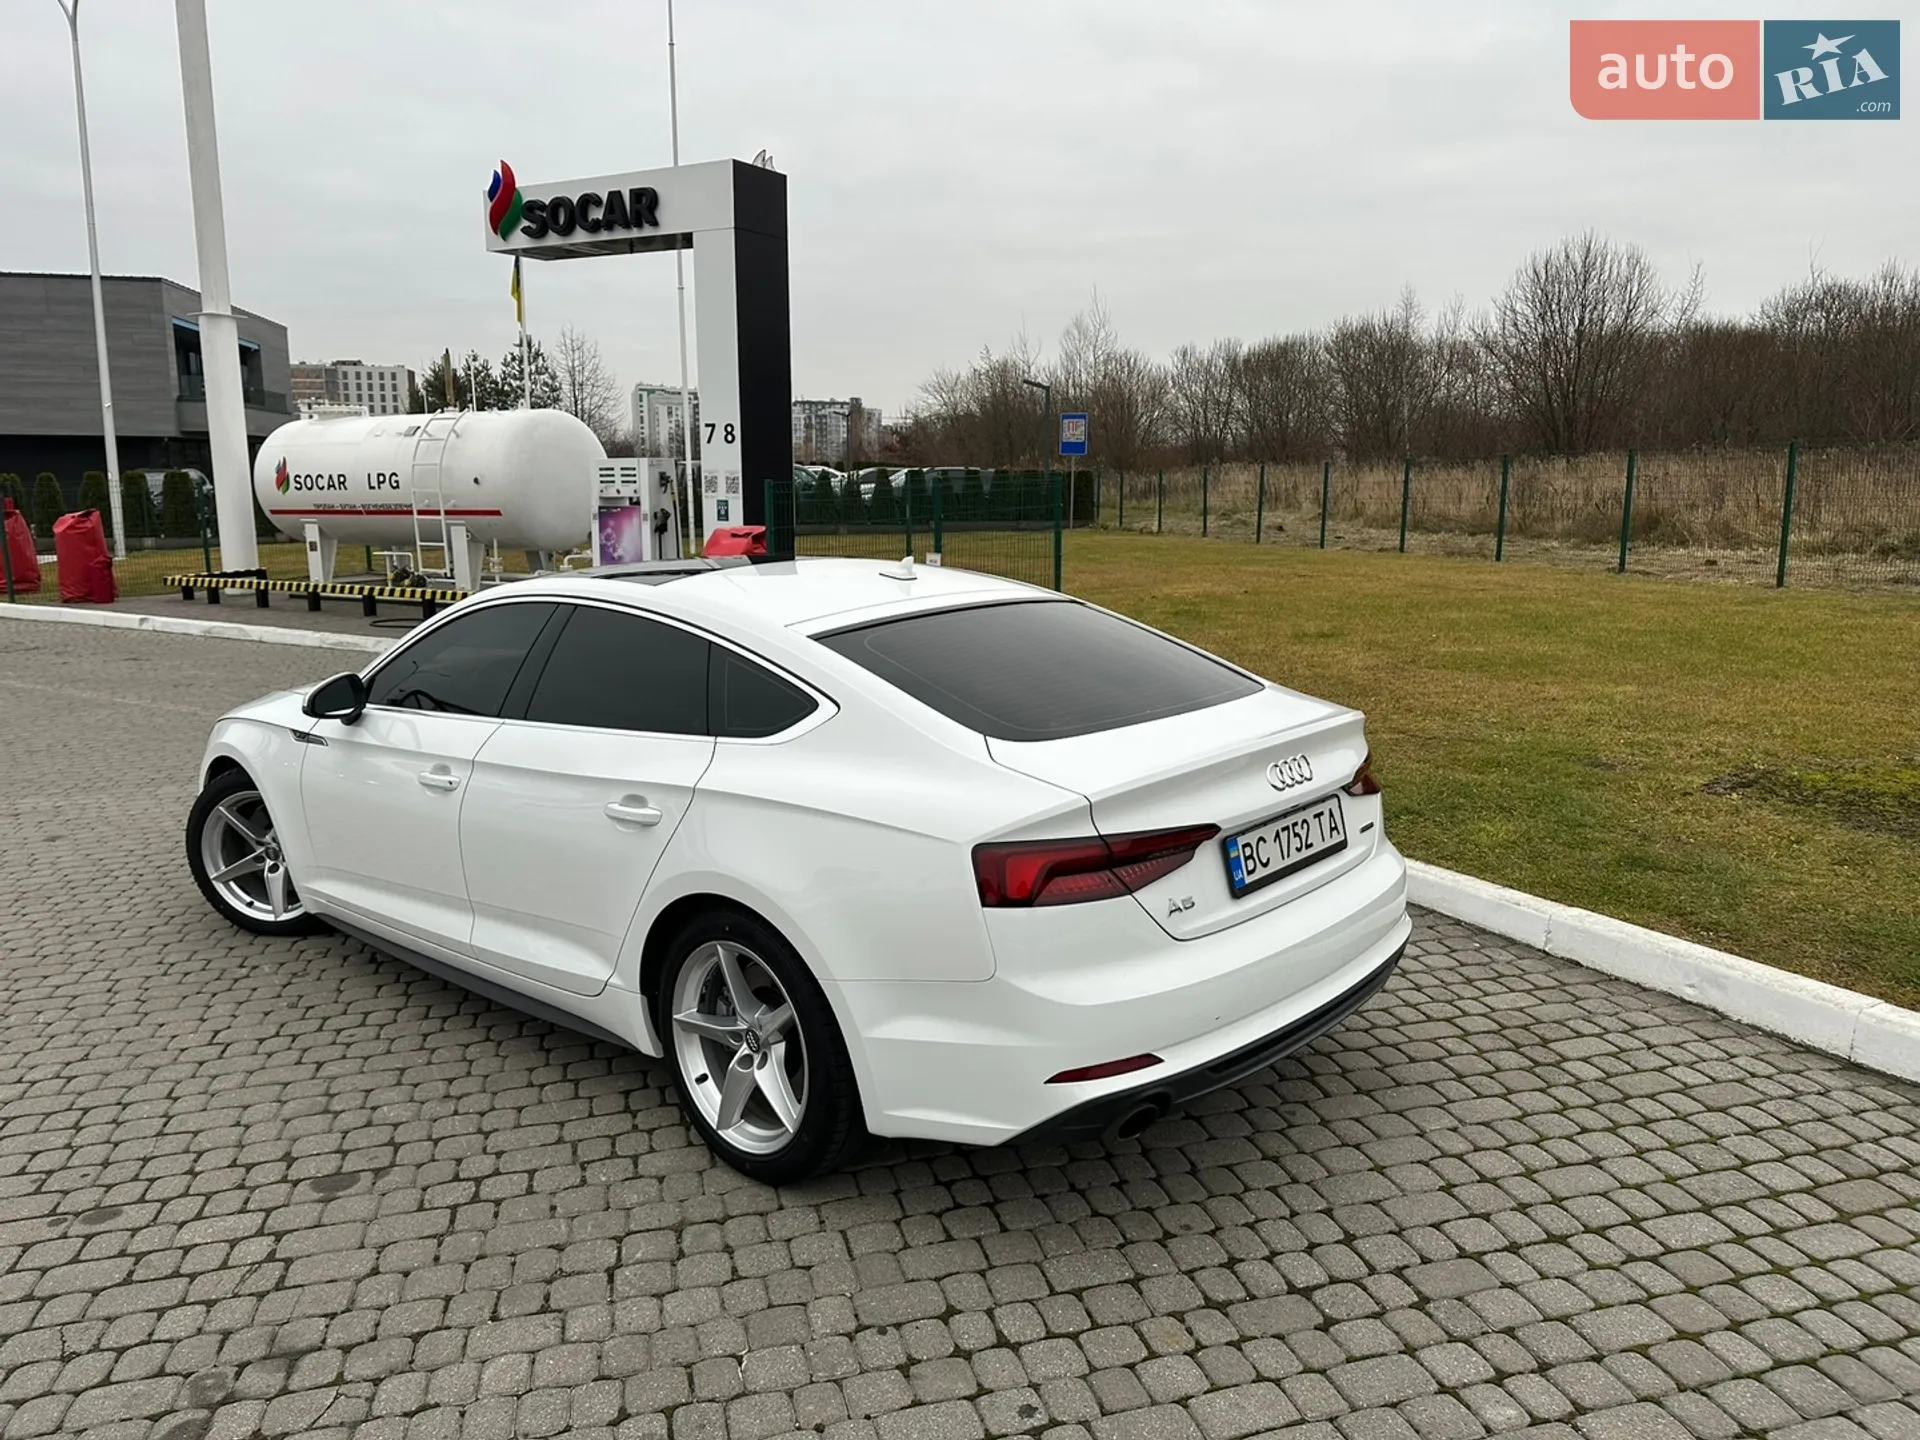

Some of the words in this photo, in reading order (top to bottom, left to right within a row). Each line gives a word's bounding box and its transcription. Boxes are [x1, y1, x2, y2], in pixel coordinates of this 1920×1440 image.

[520, 187, 660, 239] SOCAR
[704, 423, 716, 444] 7
[724, 423, 736, 444] 8
[293, 473, 348, 491] SOCAR
[367, 472, 401, 490] LPG
[1241, 835, 1271, 876] BC
[1273, 817, 1314, 861] 1752
[1313, 808, 1341, 843] TA
[1166, 895, 1196, 919] A5
